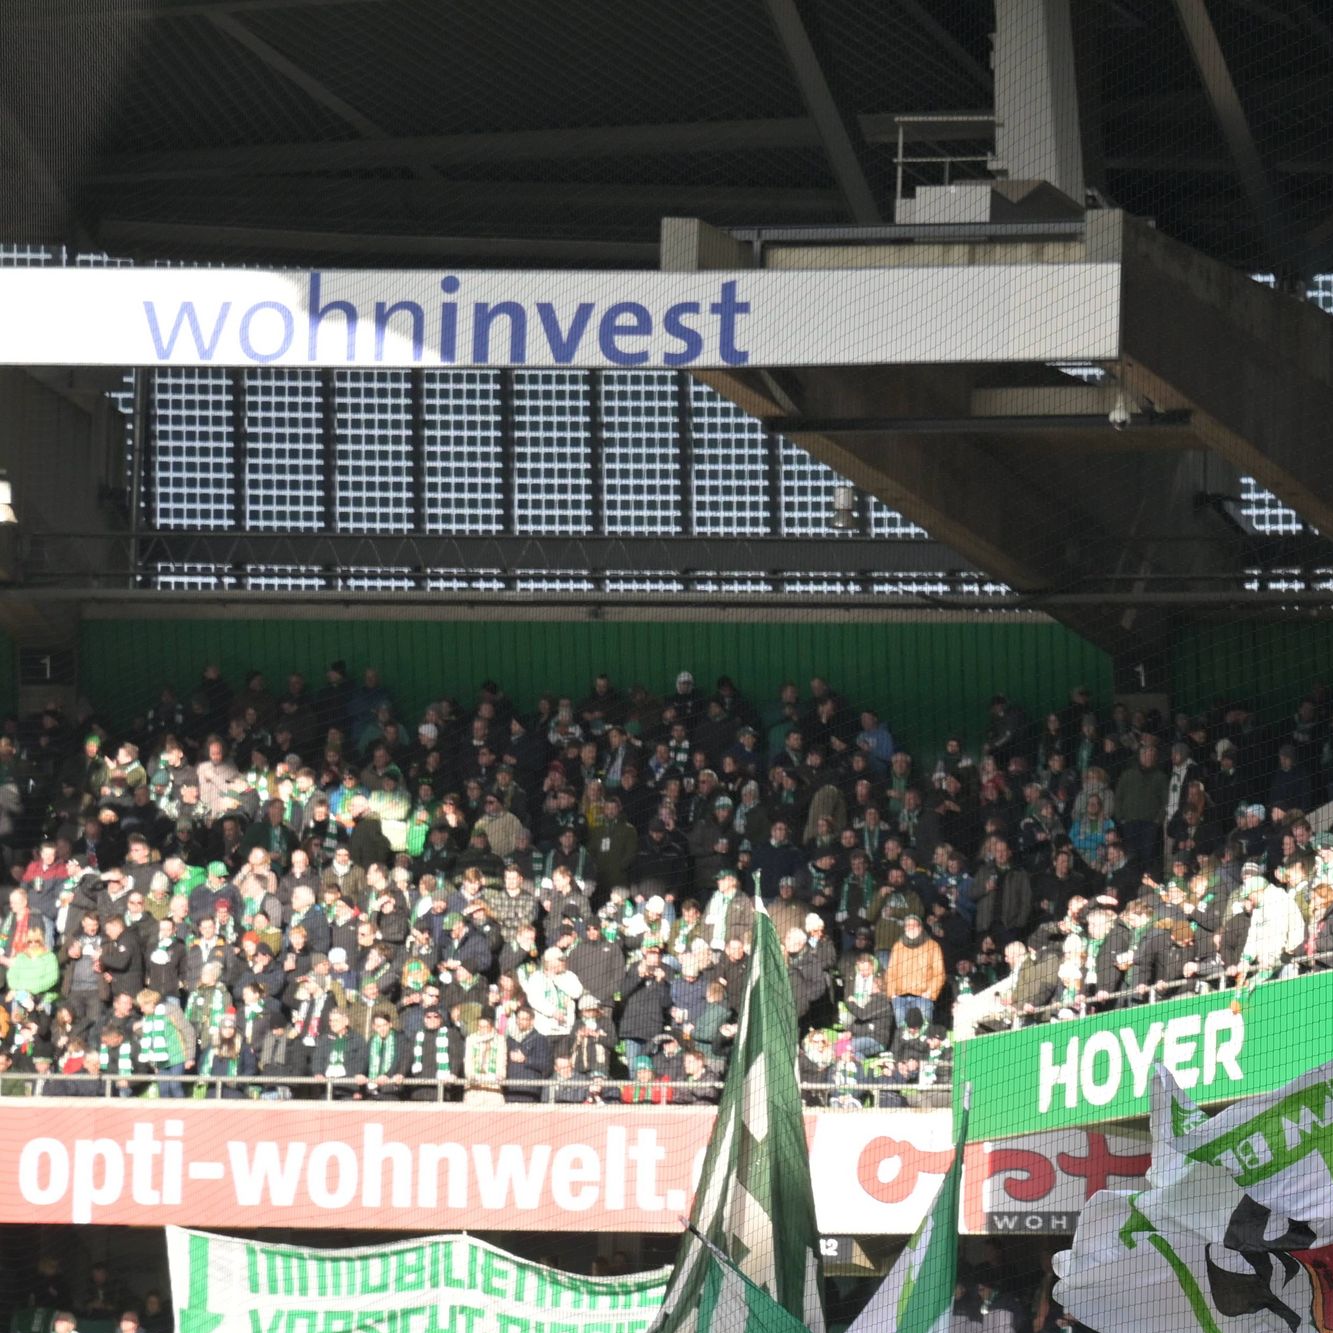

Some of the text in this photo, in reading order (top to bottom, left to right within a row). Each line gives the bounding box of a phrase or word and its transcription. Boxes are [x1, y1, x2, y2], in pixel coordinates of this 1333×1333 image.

[142, 274, 752, 368] wohninvest
[40, 655, 51, 680] 1
[1037, 1007, 1246, 1115] HOYER
[18, 1117, 690, 1224] opti-wohnwelt.
